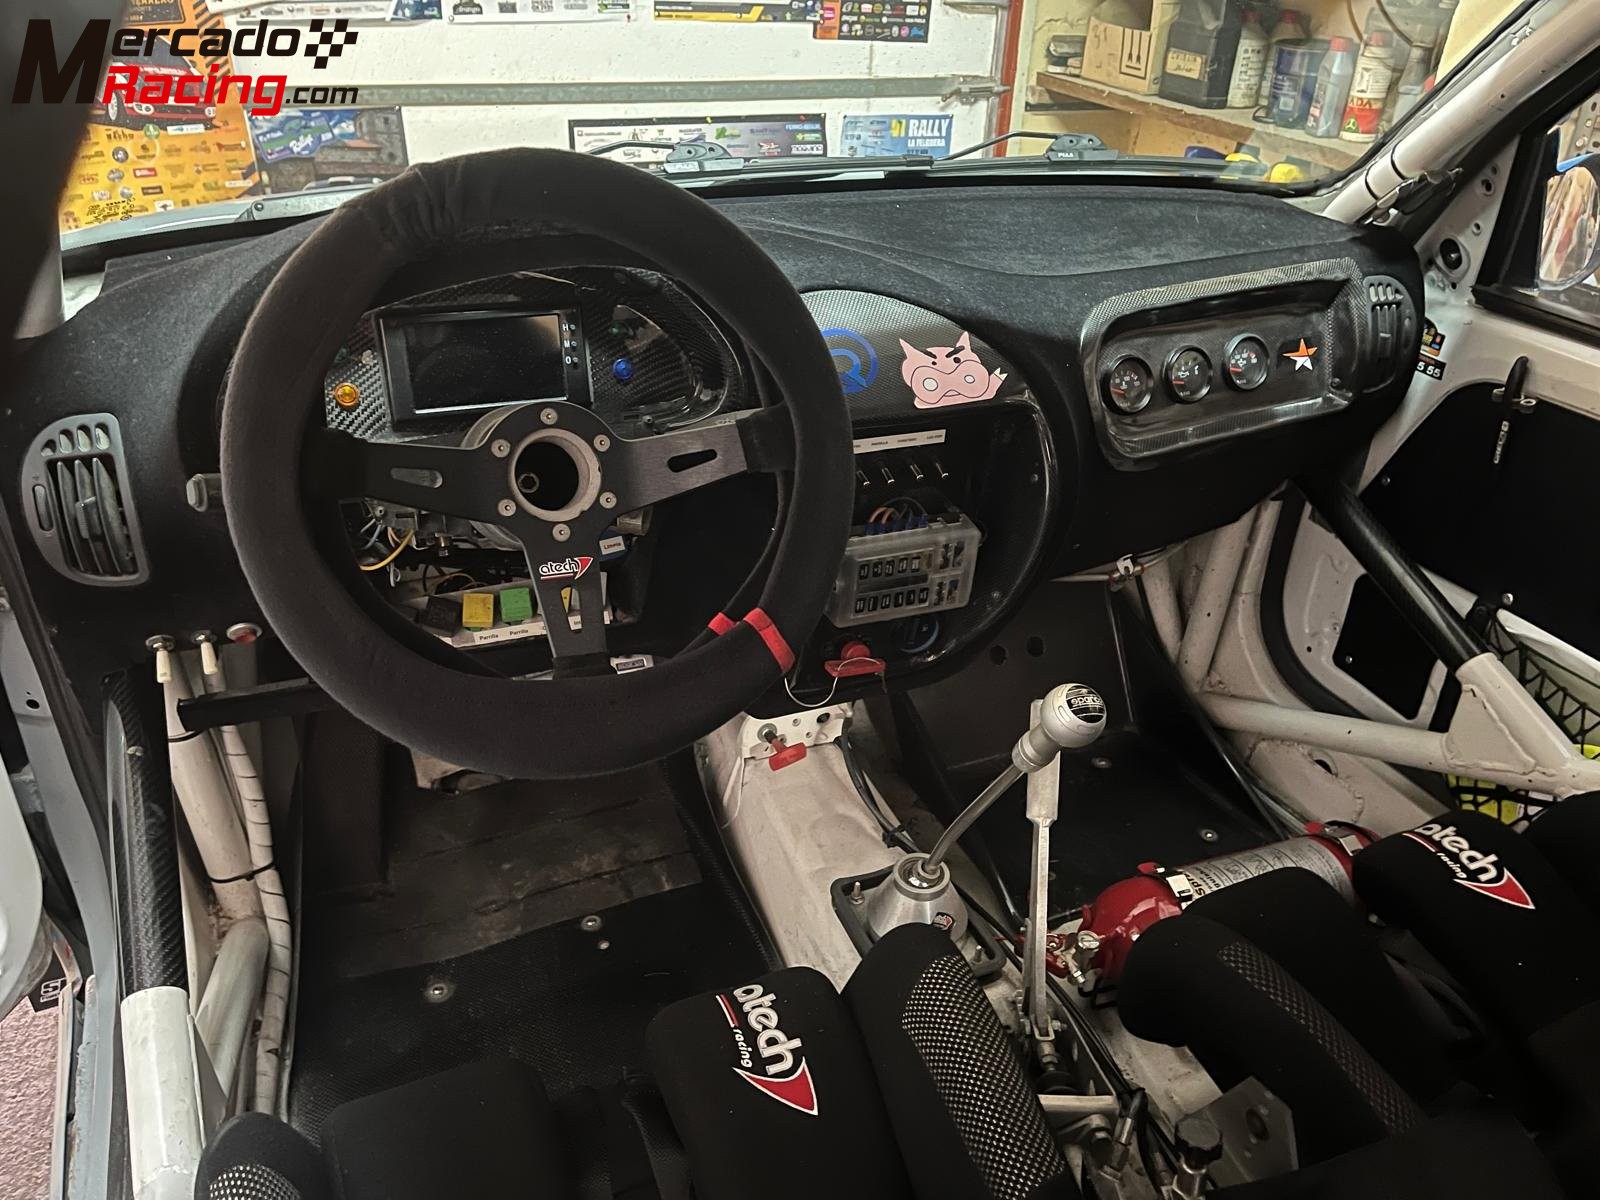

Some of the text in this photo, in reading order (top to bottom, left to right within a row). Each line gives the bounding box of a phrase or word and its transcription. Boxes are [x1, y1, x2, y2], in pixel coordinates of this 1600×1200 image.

[908, 119, 950, 137] RALLY
[539, 558, 579, 576] atech
[1414, 823, 1499, 882] atech
[733, 984, 803, 1076] atech
[733, 1028, 753, 1069] racing
